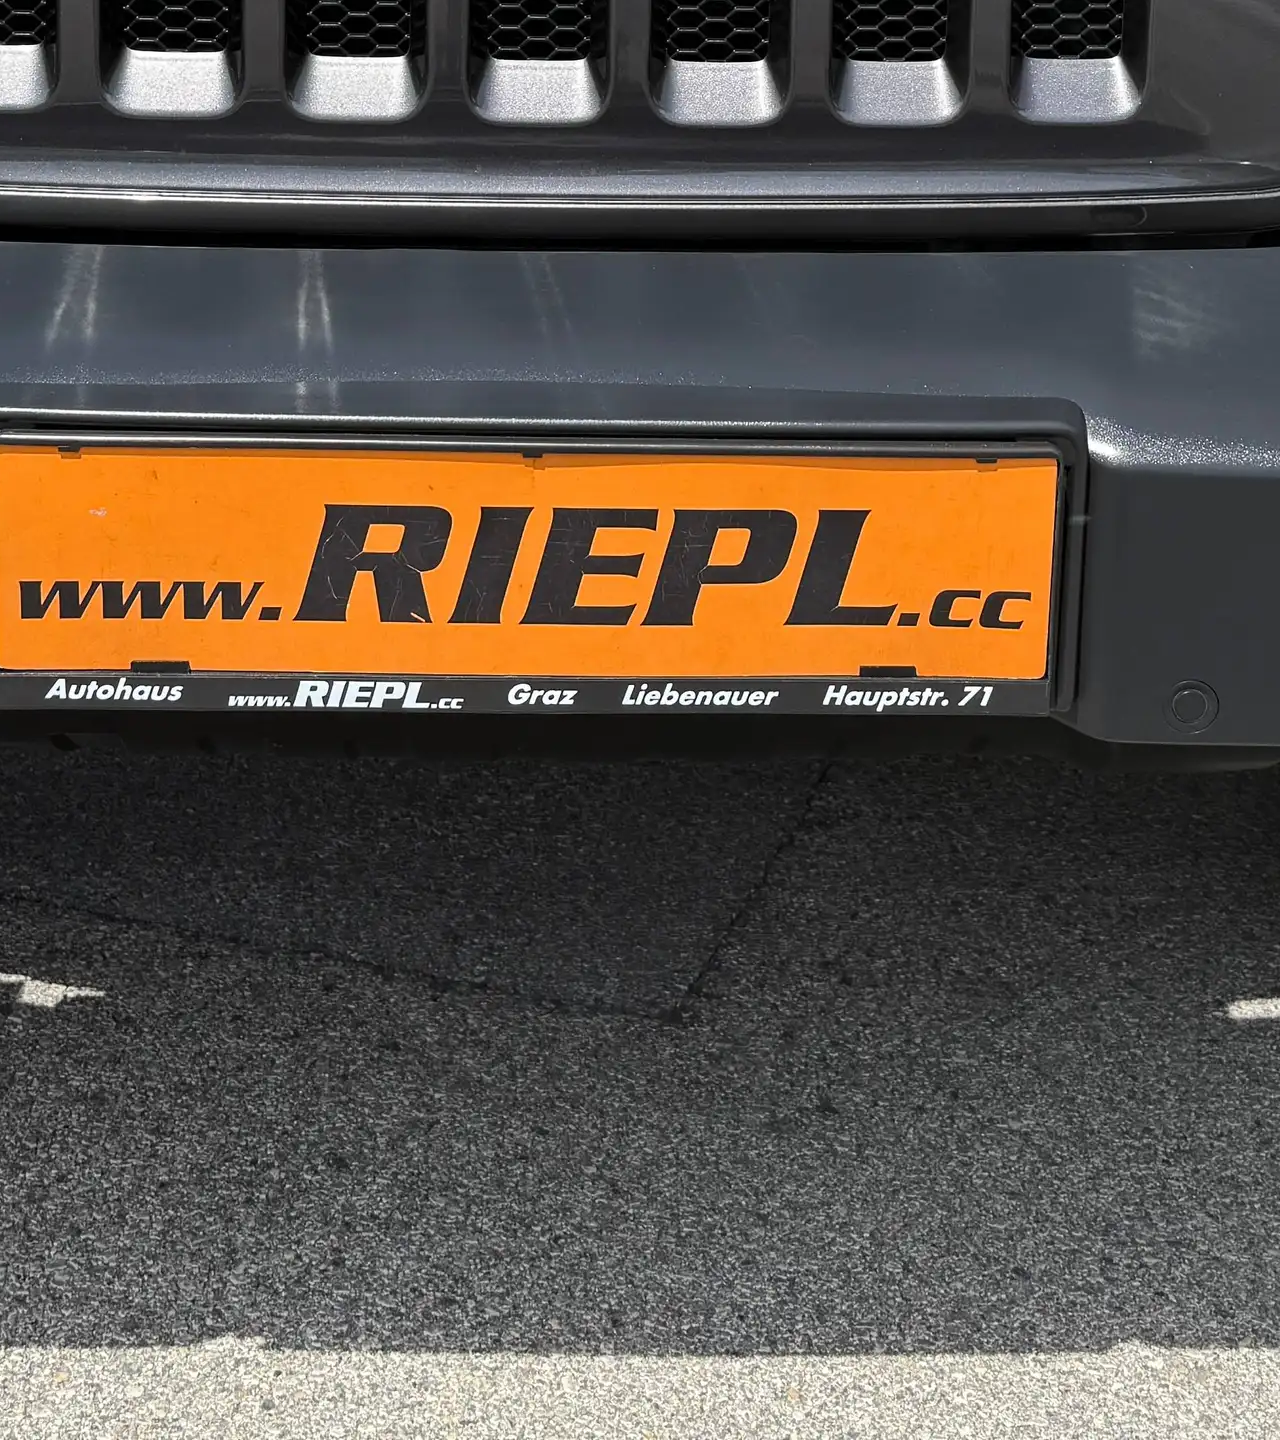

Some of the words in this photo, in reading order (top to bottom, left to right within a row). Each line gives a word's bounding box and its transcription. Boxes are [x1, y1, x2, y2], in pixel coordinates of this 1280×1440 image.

[19, 504, 1032, 630] www.RIEPL.cc
[44, 678, 184, 702] Autohaus
[227, 680, 465, 710] www.RIEPL.cc
[507, 683, 578, 706] Graz
[621, 682, 780, 706] Liebenauer
[822, 684, 949, 713] Hauptstr.
[957, 685, 994, 707] 71
